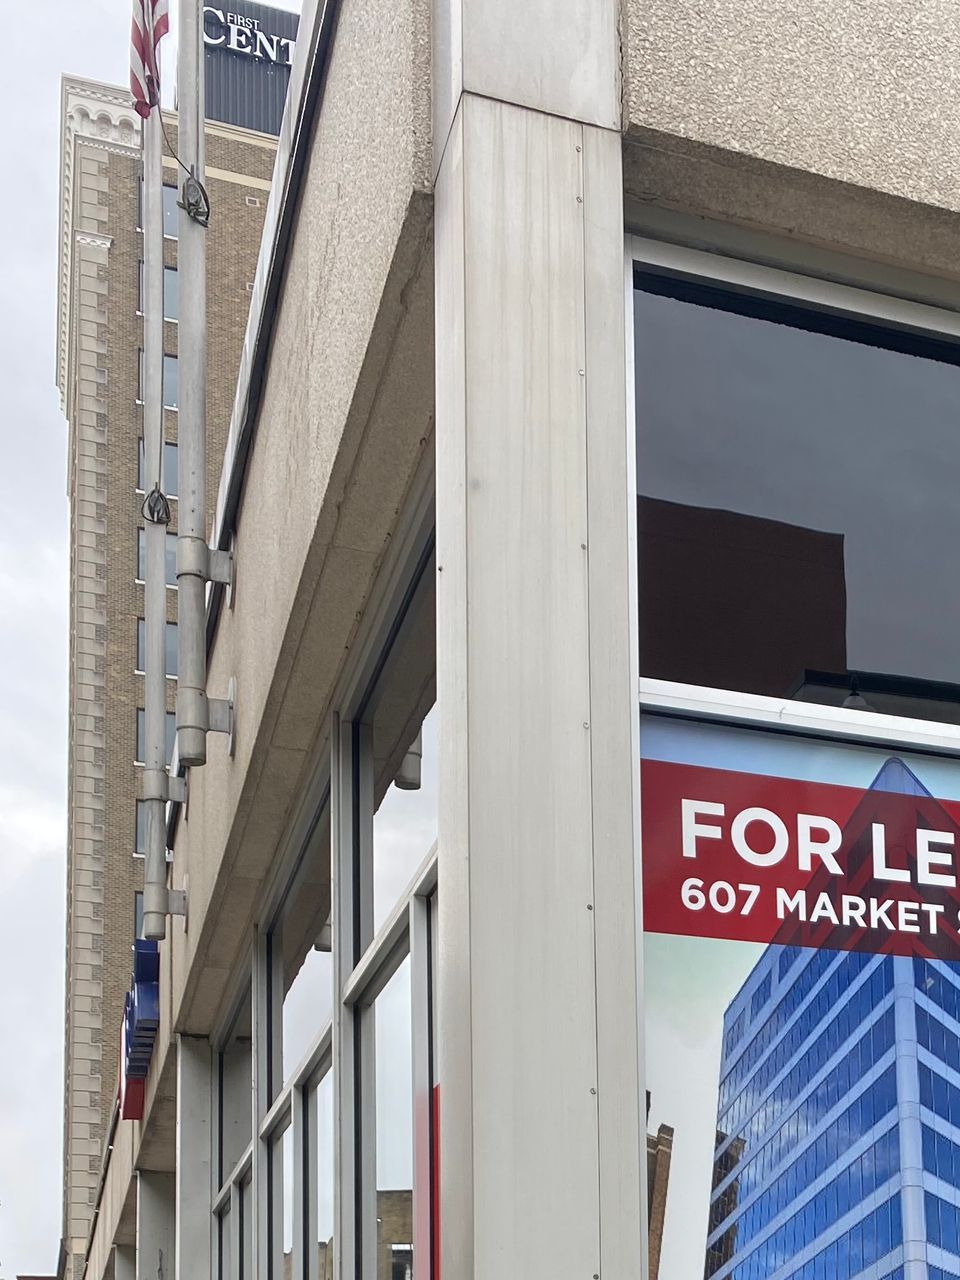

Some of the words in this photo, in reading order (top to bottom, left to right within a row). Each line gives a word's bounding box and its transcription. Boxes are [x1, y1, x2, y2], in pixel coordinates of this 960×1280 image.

[227, 12, 260, 31] FIRST
[681, 798, 845, 876] FOR
[680, 877, 761, 916] 607
[776, 887, 945, 935] MARKET
